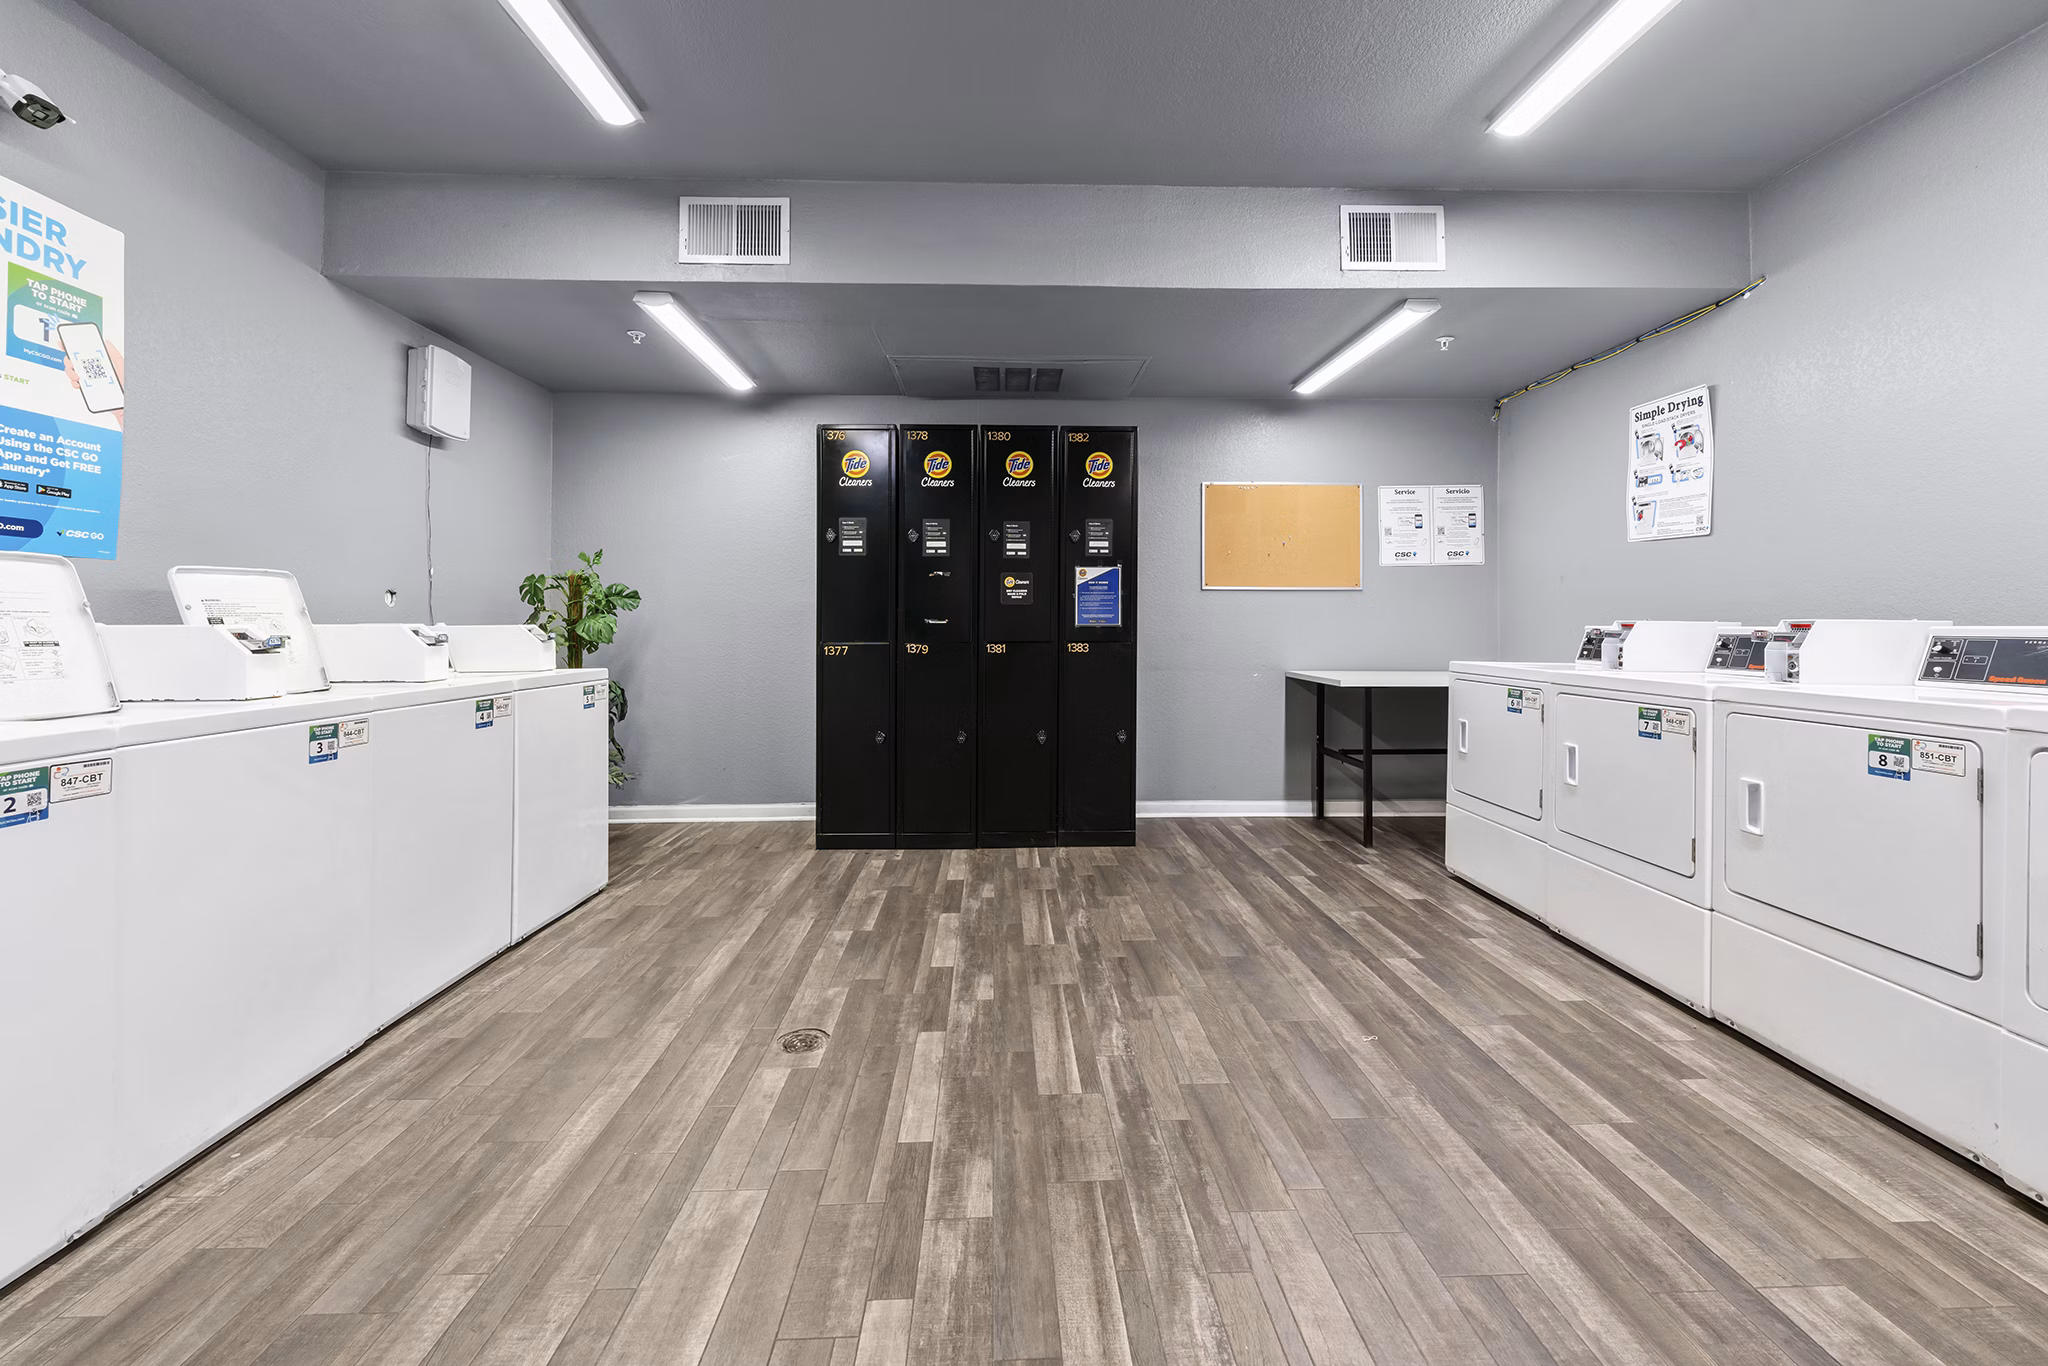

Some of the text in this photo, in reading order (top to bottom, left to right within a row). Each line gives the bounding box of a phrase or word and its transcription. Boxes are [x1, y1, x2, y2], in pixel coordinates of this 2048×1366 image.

[0, 228, 87, 280] NDRY
[26, 278, 87, 307] TAP PHONE
[32, 289, 83, 313] TO START
[4, 373, 30, 385] START
[1634, 404, 1666, 423] Simple
[1667, 395, 1704, 413] Drying
[0, 423, 102, 453] Create an Account
[906, 431, 929, 441] 1378
[987, 431, 1011, 441] 1380
[1068, 433, 1089, 442] 1382
[34, 443, 53, 454] the
[56, 446, 79, 459] CSC
[82, 452, 99, 463] GO
[24, 453, 48, 465] and
[50, 457, 71, 468] Get
[73, 461, 102, 474] FREE
[845, 456, 867, 473] Tide
[927, 457, 949, 474] Tide
[1008, 457, 1031, 474] Tide
[1088, 458, 1110, 475] Tide
[0, 462, 51, 478] aundry
[839, 476, 873, 487] Cleaners
[921, 477, 955, 487] Cleaners
[1002, 477, 1036, 487] Cleaners
[1082, 478, 1116, 488] Cleaners
[66, 529, 105, 540] CSC GO
[823, 645, 849, 656] 1377
[905, 643, 929, 654] 1379
[986, 643, 1006, 654] 1381
[1067, 642, 1090, 653] 1383
[1643, 721, 1649, 730] 7
[316, 742, 323, 754] 3
[1885, 738, 1905, 746] PHONE
[1878, 754, 1888, 767] 8
[1919, 751, 1957, 763] 851-CBT
[0, 770, 41, 783] AP PHONE
[0, 776, 37, 788] TO START
[60, 772, 104, 787] 847-CBT
[3, 796, 17, 814] 2
